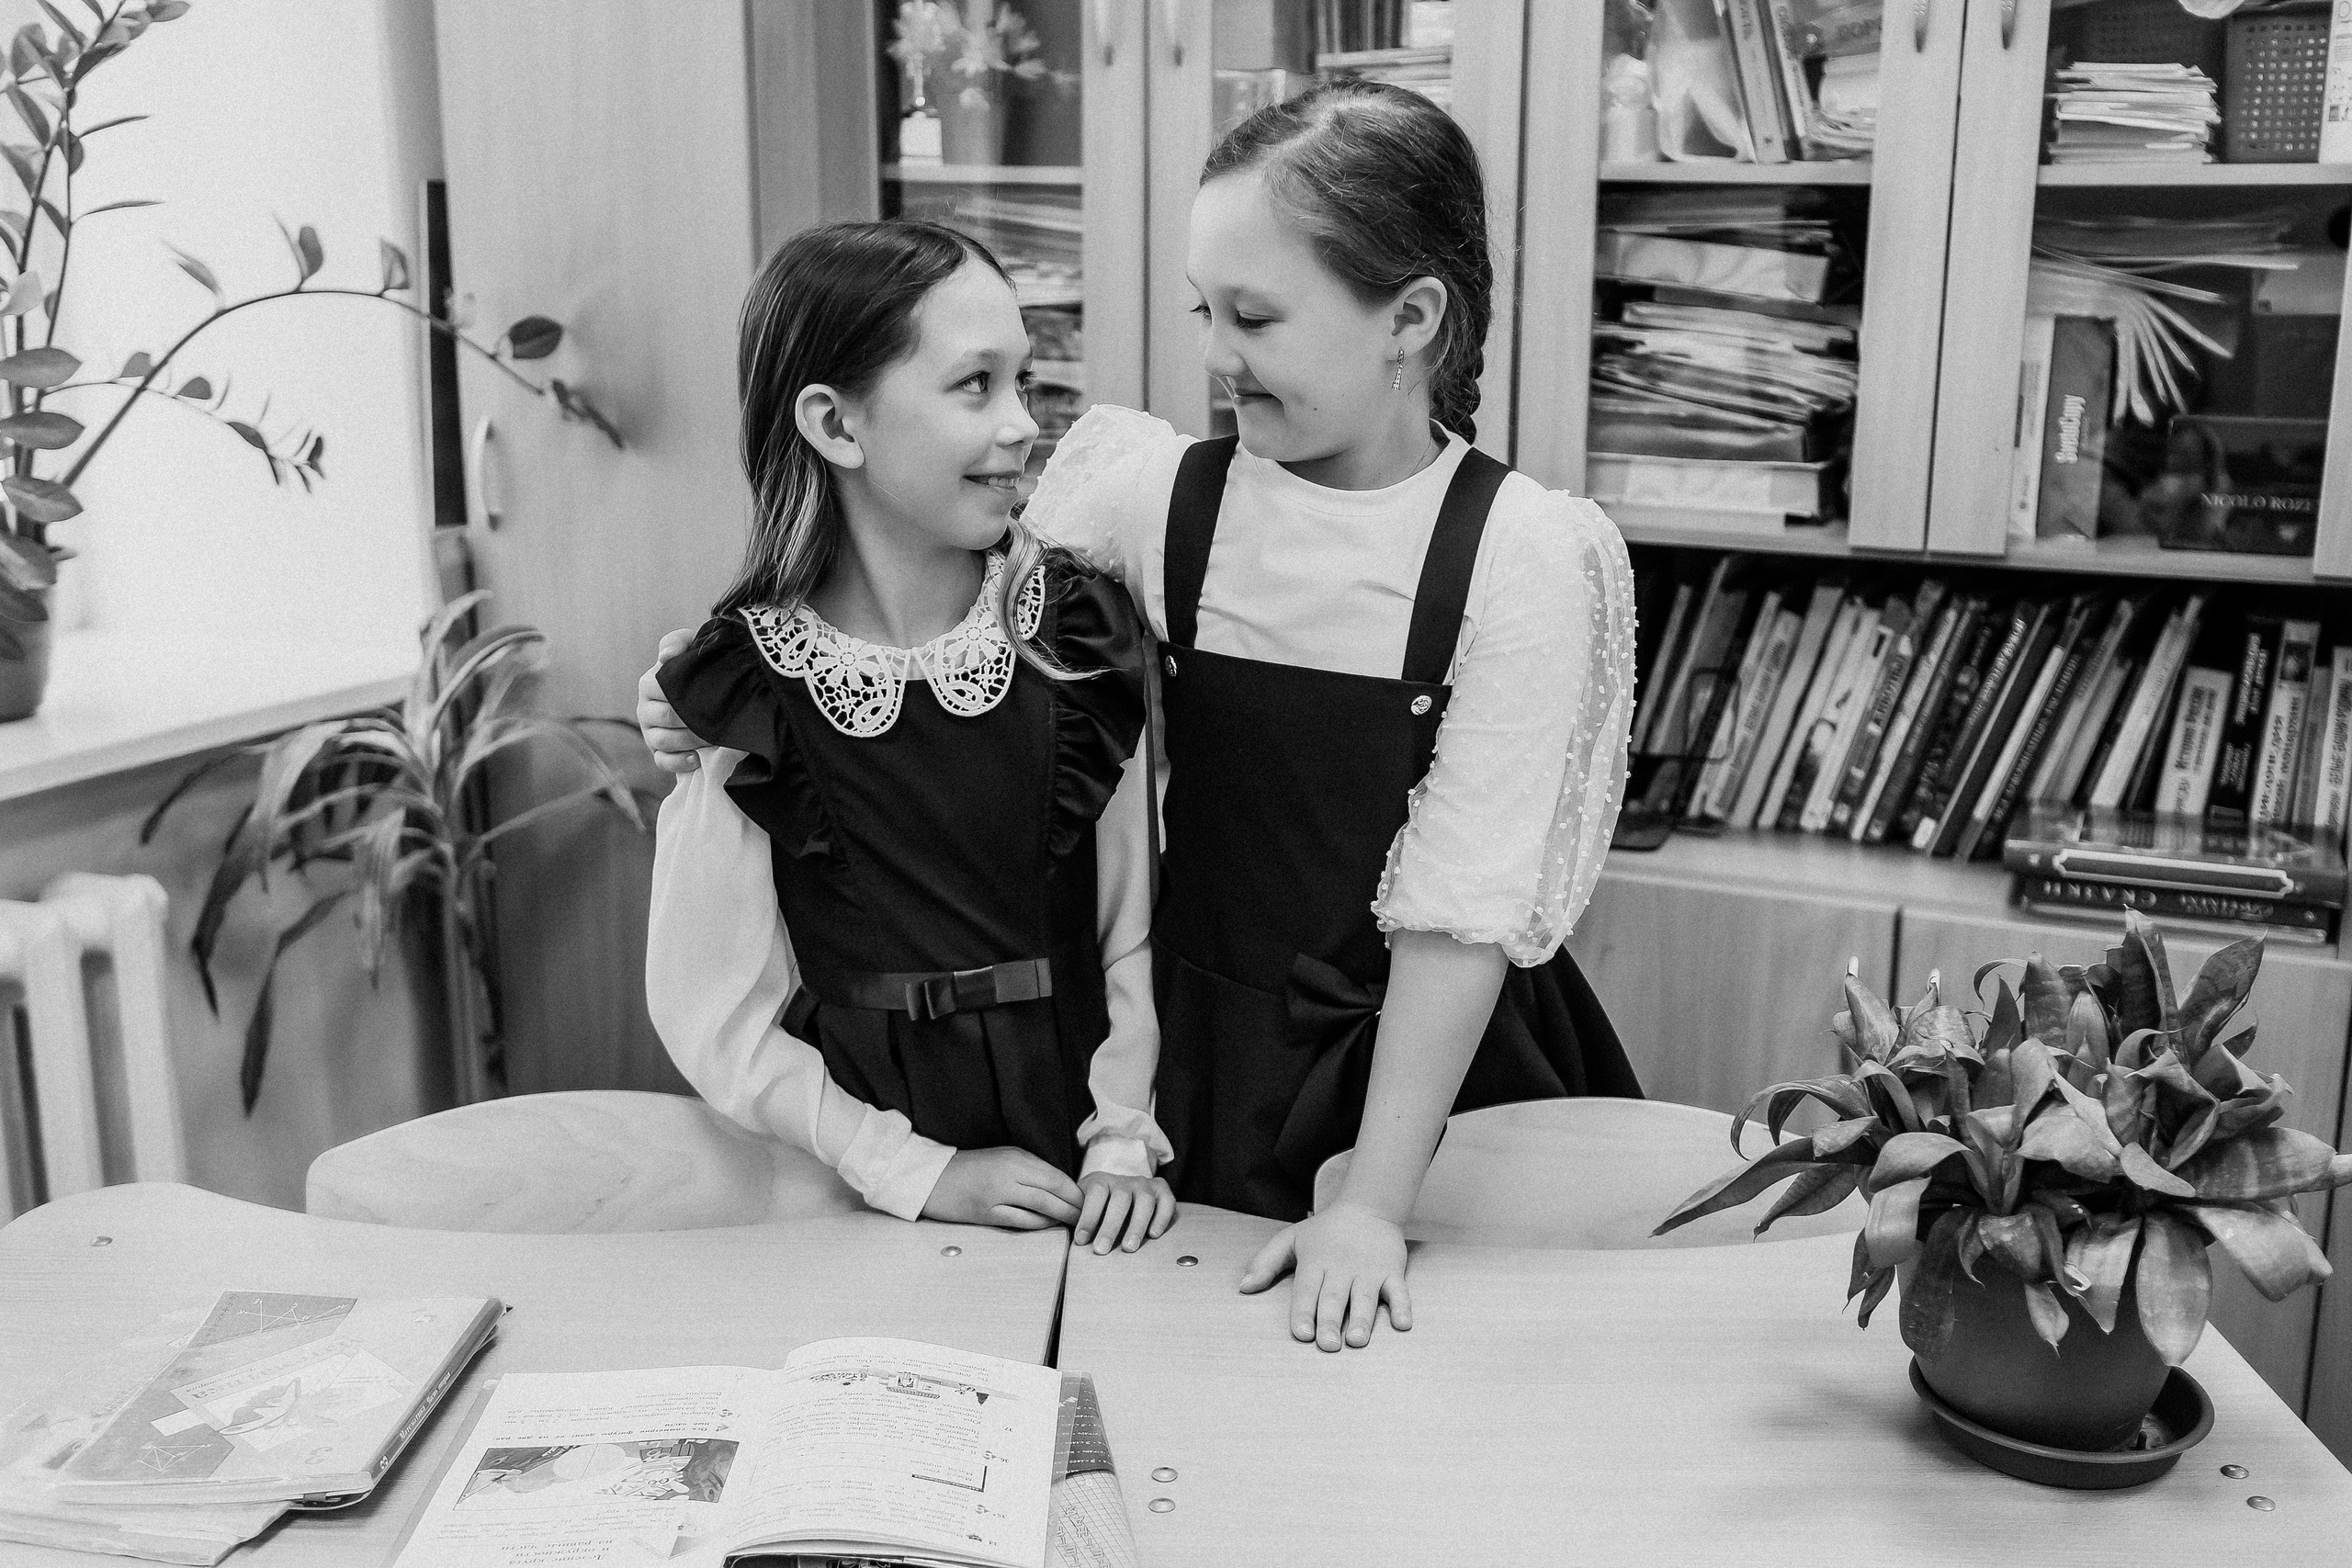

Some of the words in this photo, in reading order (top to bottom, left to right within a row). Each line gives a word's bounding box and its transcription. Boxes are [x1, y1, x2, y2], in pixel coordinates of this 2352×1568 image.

[2200, 492, 2267, 508] NICOLO
[380, 1455, 389, 1470] 3
[400, 1405, 426, 1442] Математика
[515, 1548, 595, 1557] окружности
